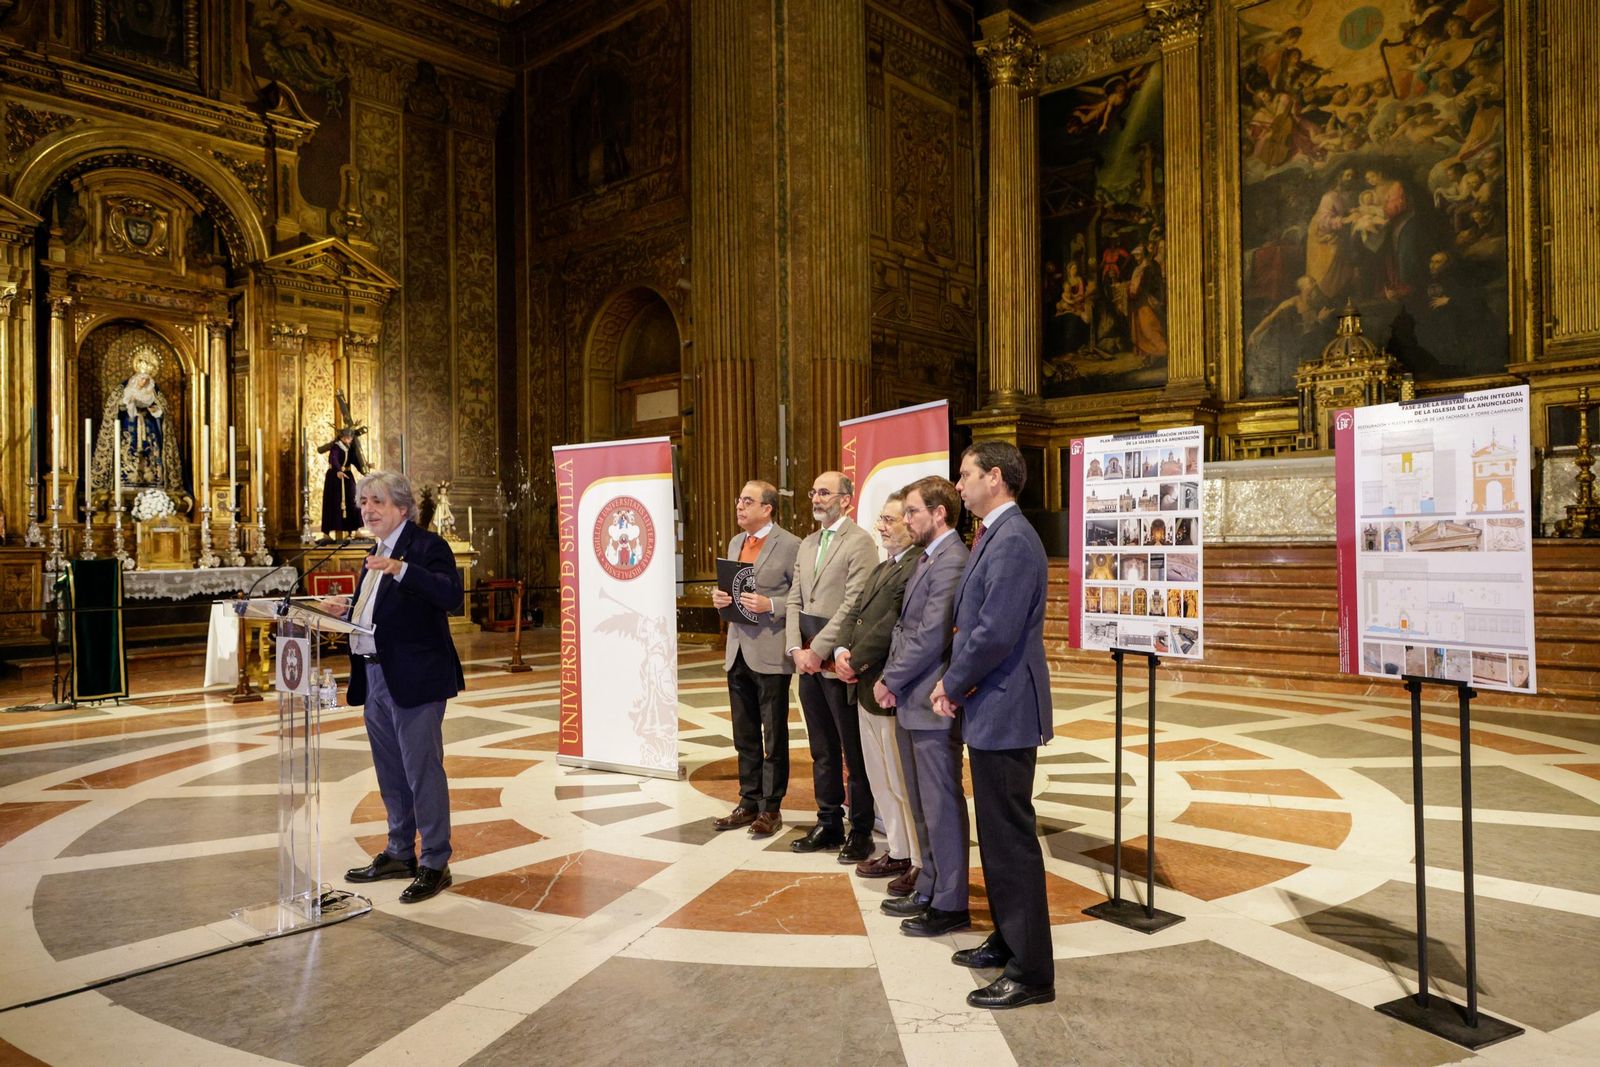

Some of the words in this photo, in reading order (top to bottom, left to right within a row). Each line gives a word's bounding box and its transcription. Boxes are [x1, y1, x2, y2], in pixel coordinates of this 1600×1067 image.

[1432, 406, 1456, 414] IGLESIA
[1490, 391, 1523, 400] INTEGRAL
[558, 458, 575, 552] SEVILLA
[561, 585, 579, 744] UNIVERSIDAD
